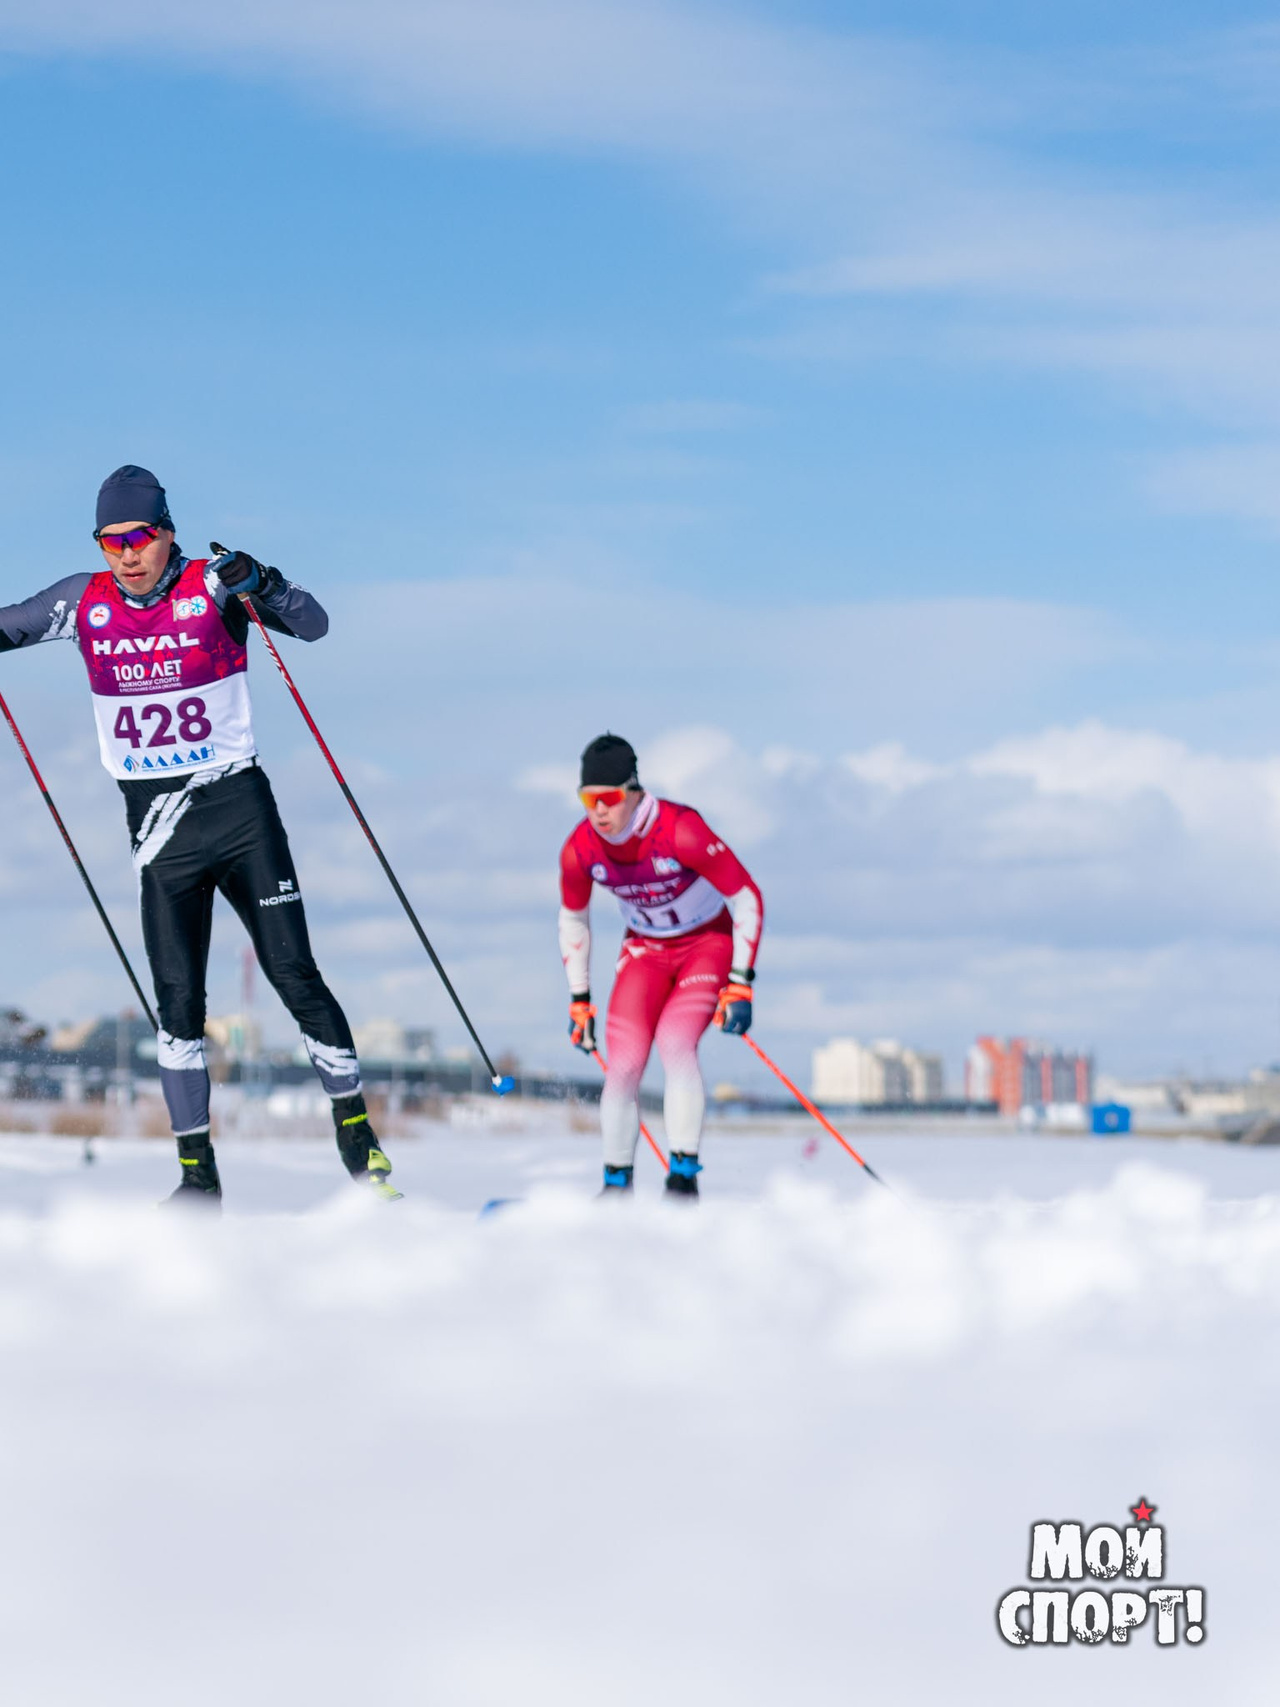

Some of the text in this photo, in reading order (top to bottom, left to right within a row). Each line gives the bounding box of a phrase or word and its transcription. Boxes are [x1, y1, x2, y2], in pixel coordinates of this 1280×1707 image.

[92, 632, 200, 656] HAVAL
[112, 659, 183, 682] 100 ЛЕТ
[114, 696, 213, 749] 428
